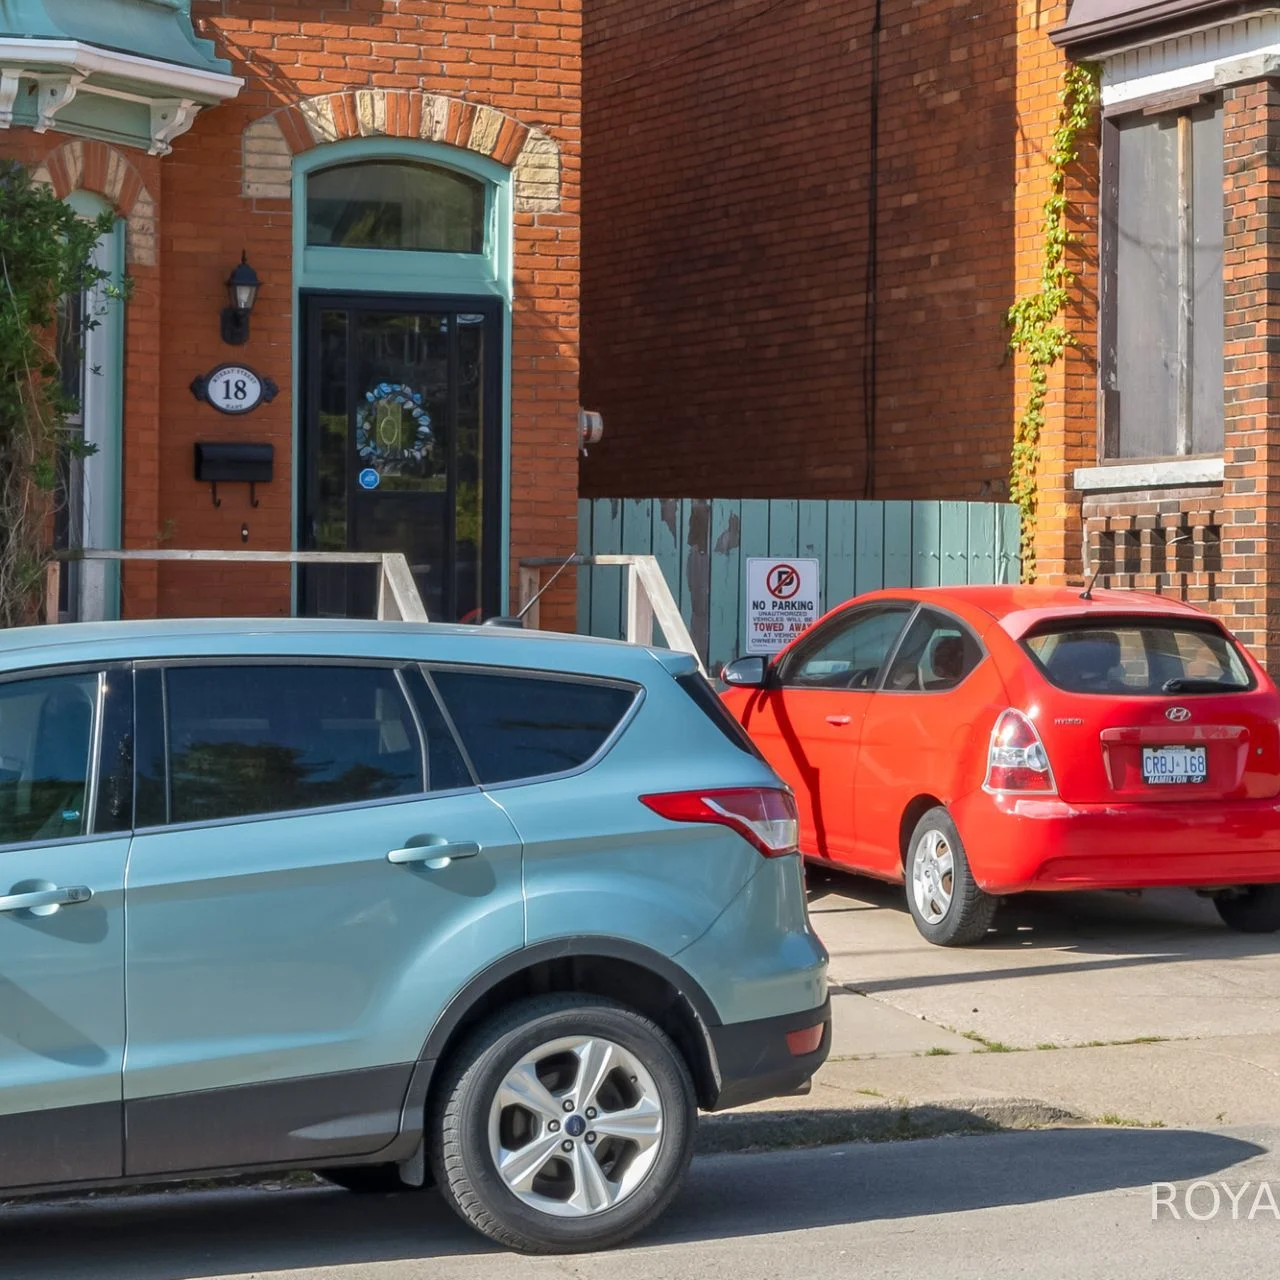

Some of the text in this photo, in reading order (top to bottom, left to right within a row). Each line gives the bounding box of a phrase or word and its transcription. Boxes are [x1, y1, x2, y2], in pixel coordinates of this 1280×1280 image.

[222, 379, 247, 400] 18
[752, 600, 814, 610] NO PARKING
[753, 622, 784, 632] TOWED
[1145, 755, 1205, 774] CRBJ 168
[1148, 775, 1188, 784] HAMILTON
